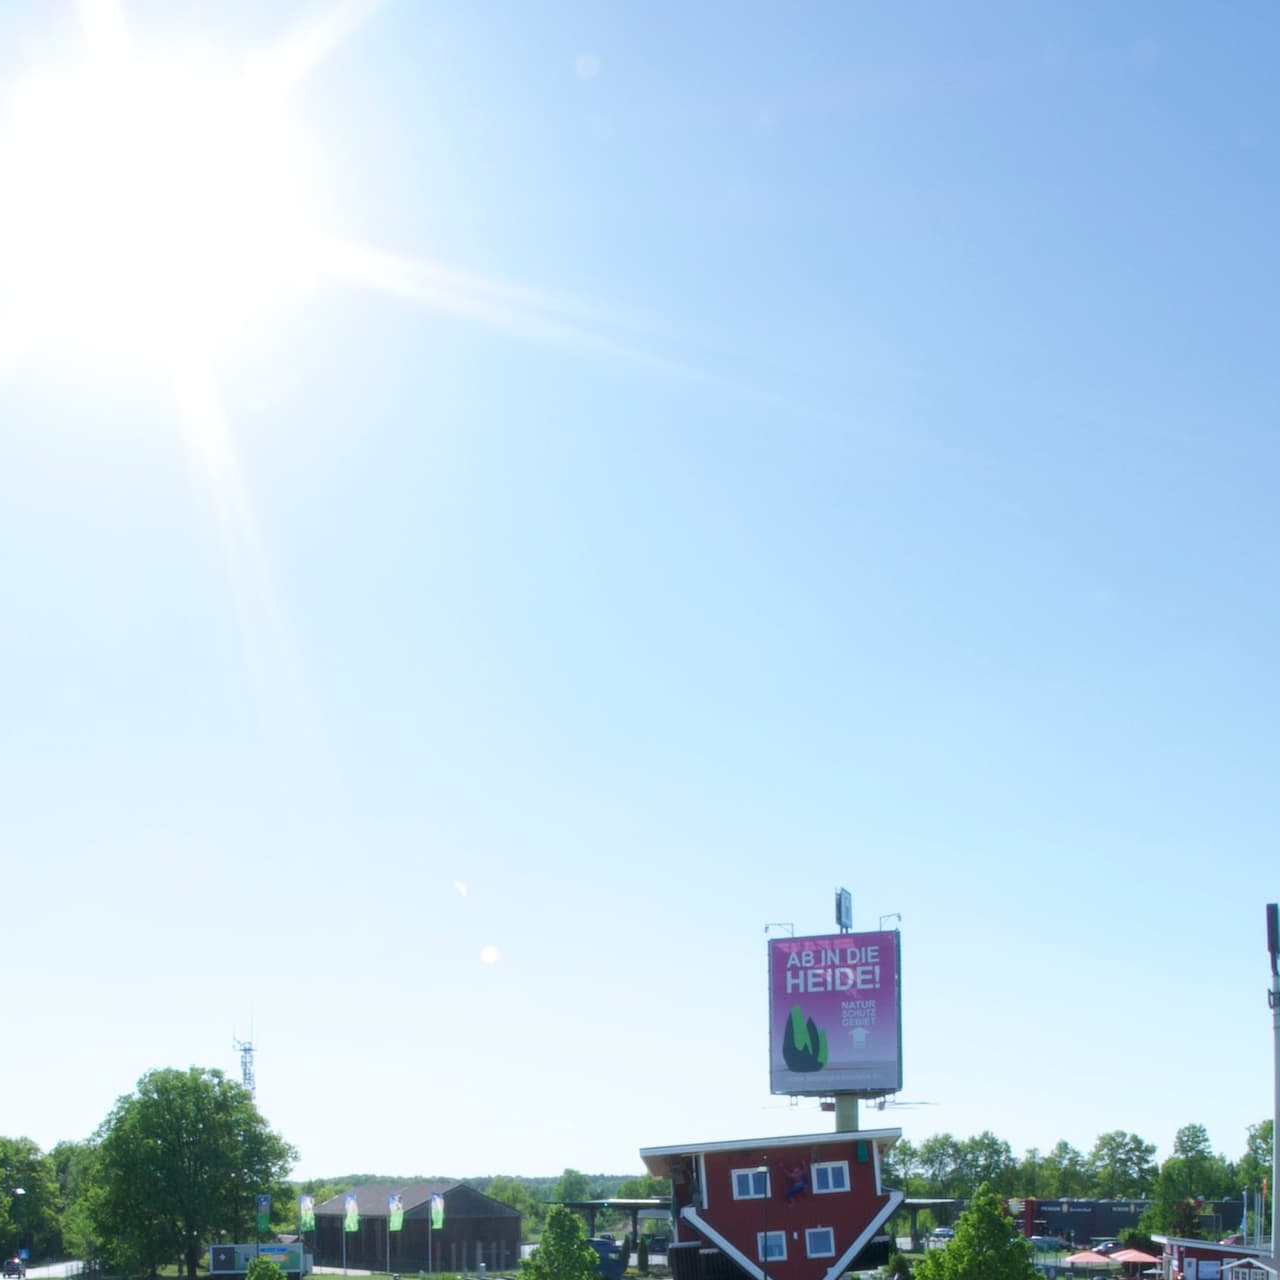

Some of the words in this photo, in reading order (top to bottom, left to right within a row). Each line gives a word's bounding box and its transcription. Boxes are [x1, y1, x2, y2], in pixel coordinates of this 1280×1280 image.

[787, 951, 814, 968] AB
[821, 948, 839, 965] IN
[846, 946, 880, 965] DIE
[786, 965, 880, 994] HEIDE!
[841, 1000, 876, 1010] NATUR
